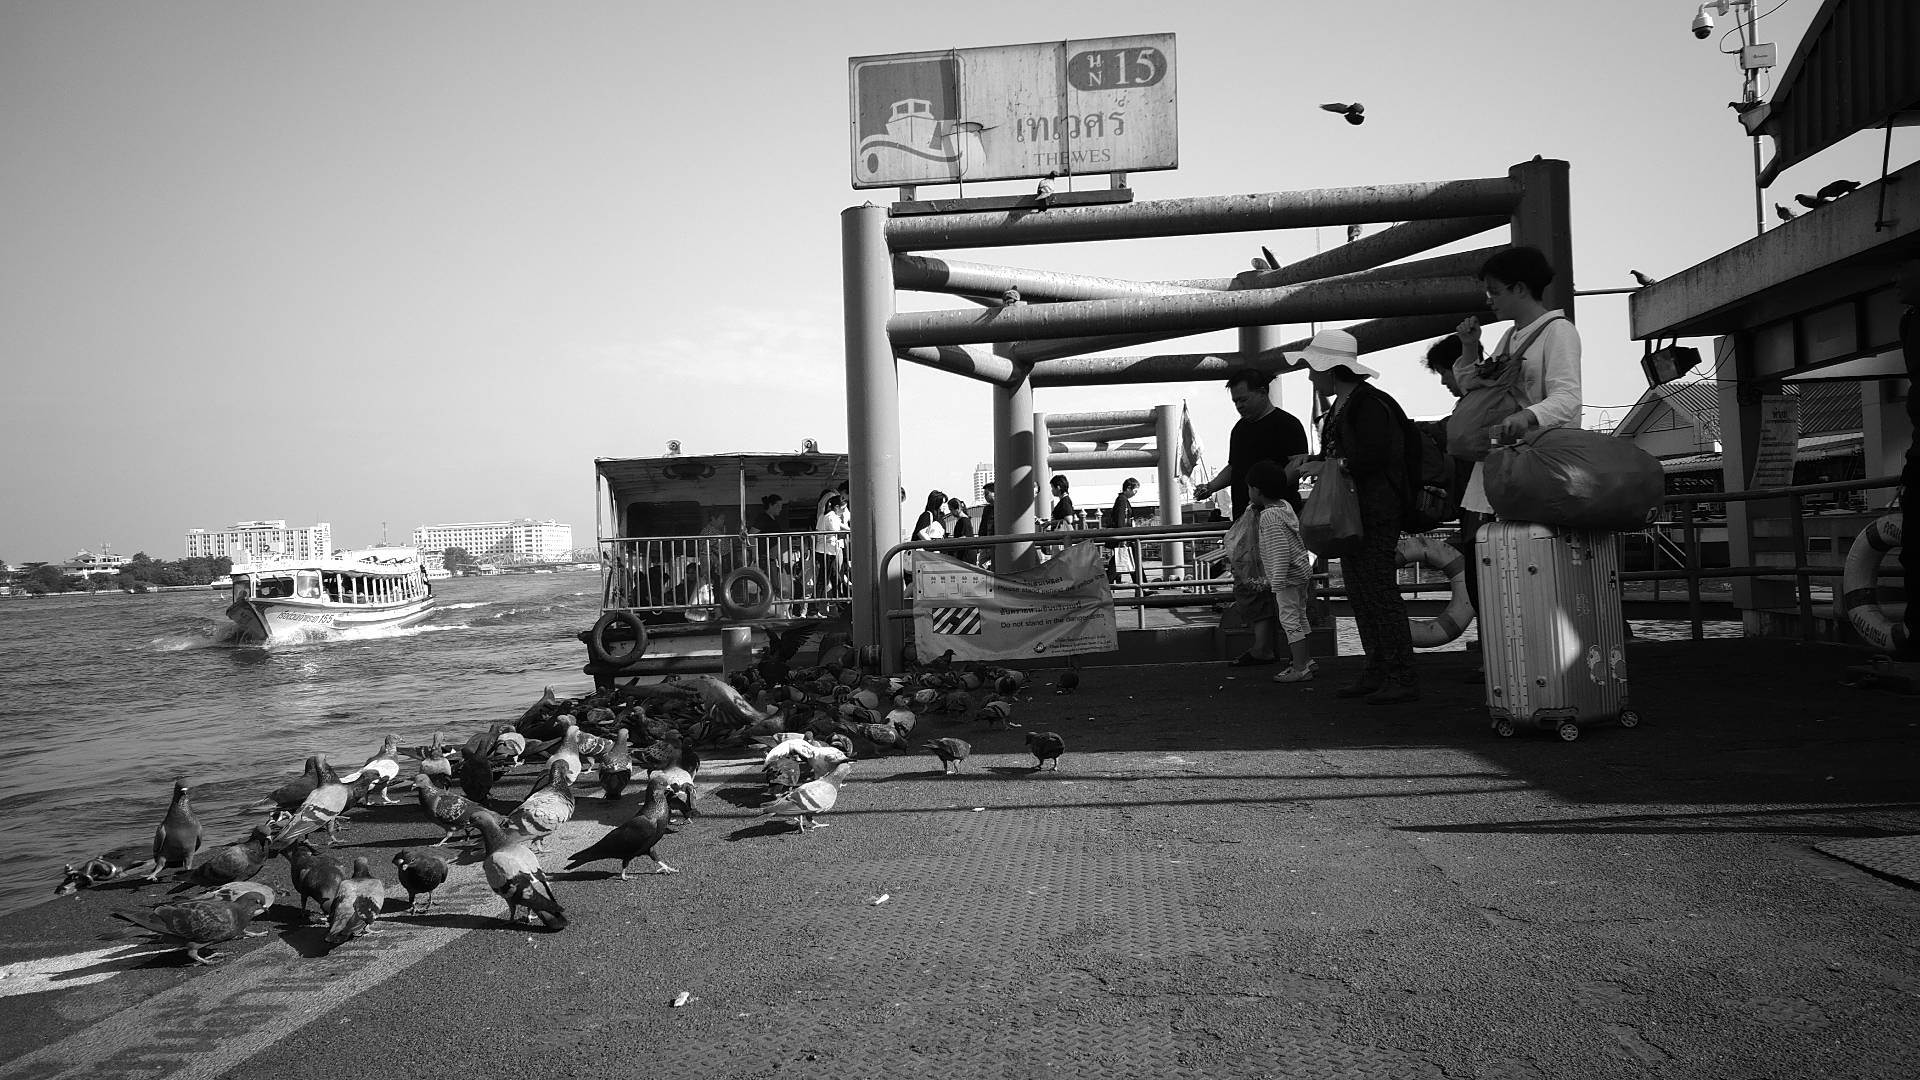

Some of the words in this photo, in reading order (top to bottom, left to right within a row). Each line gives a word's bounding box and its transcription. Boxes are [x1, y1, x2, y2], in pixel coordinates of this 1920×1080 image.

[1086, 54, 1104, 68] น
[1114, 49, 1156, 85] 15
[1088, 71, 1102, 87] N
[1016, 95, 1126, 143] เทเวศร์
[1032, 148, 1111, 166] THEWES
[318, 614, 335, 624] 155
[1012, 620, 1023, 628] not
[1025, 619, 1044, 627] stand
